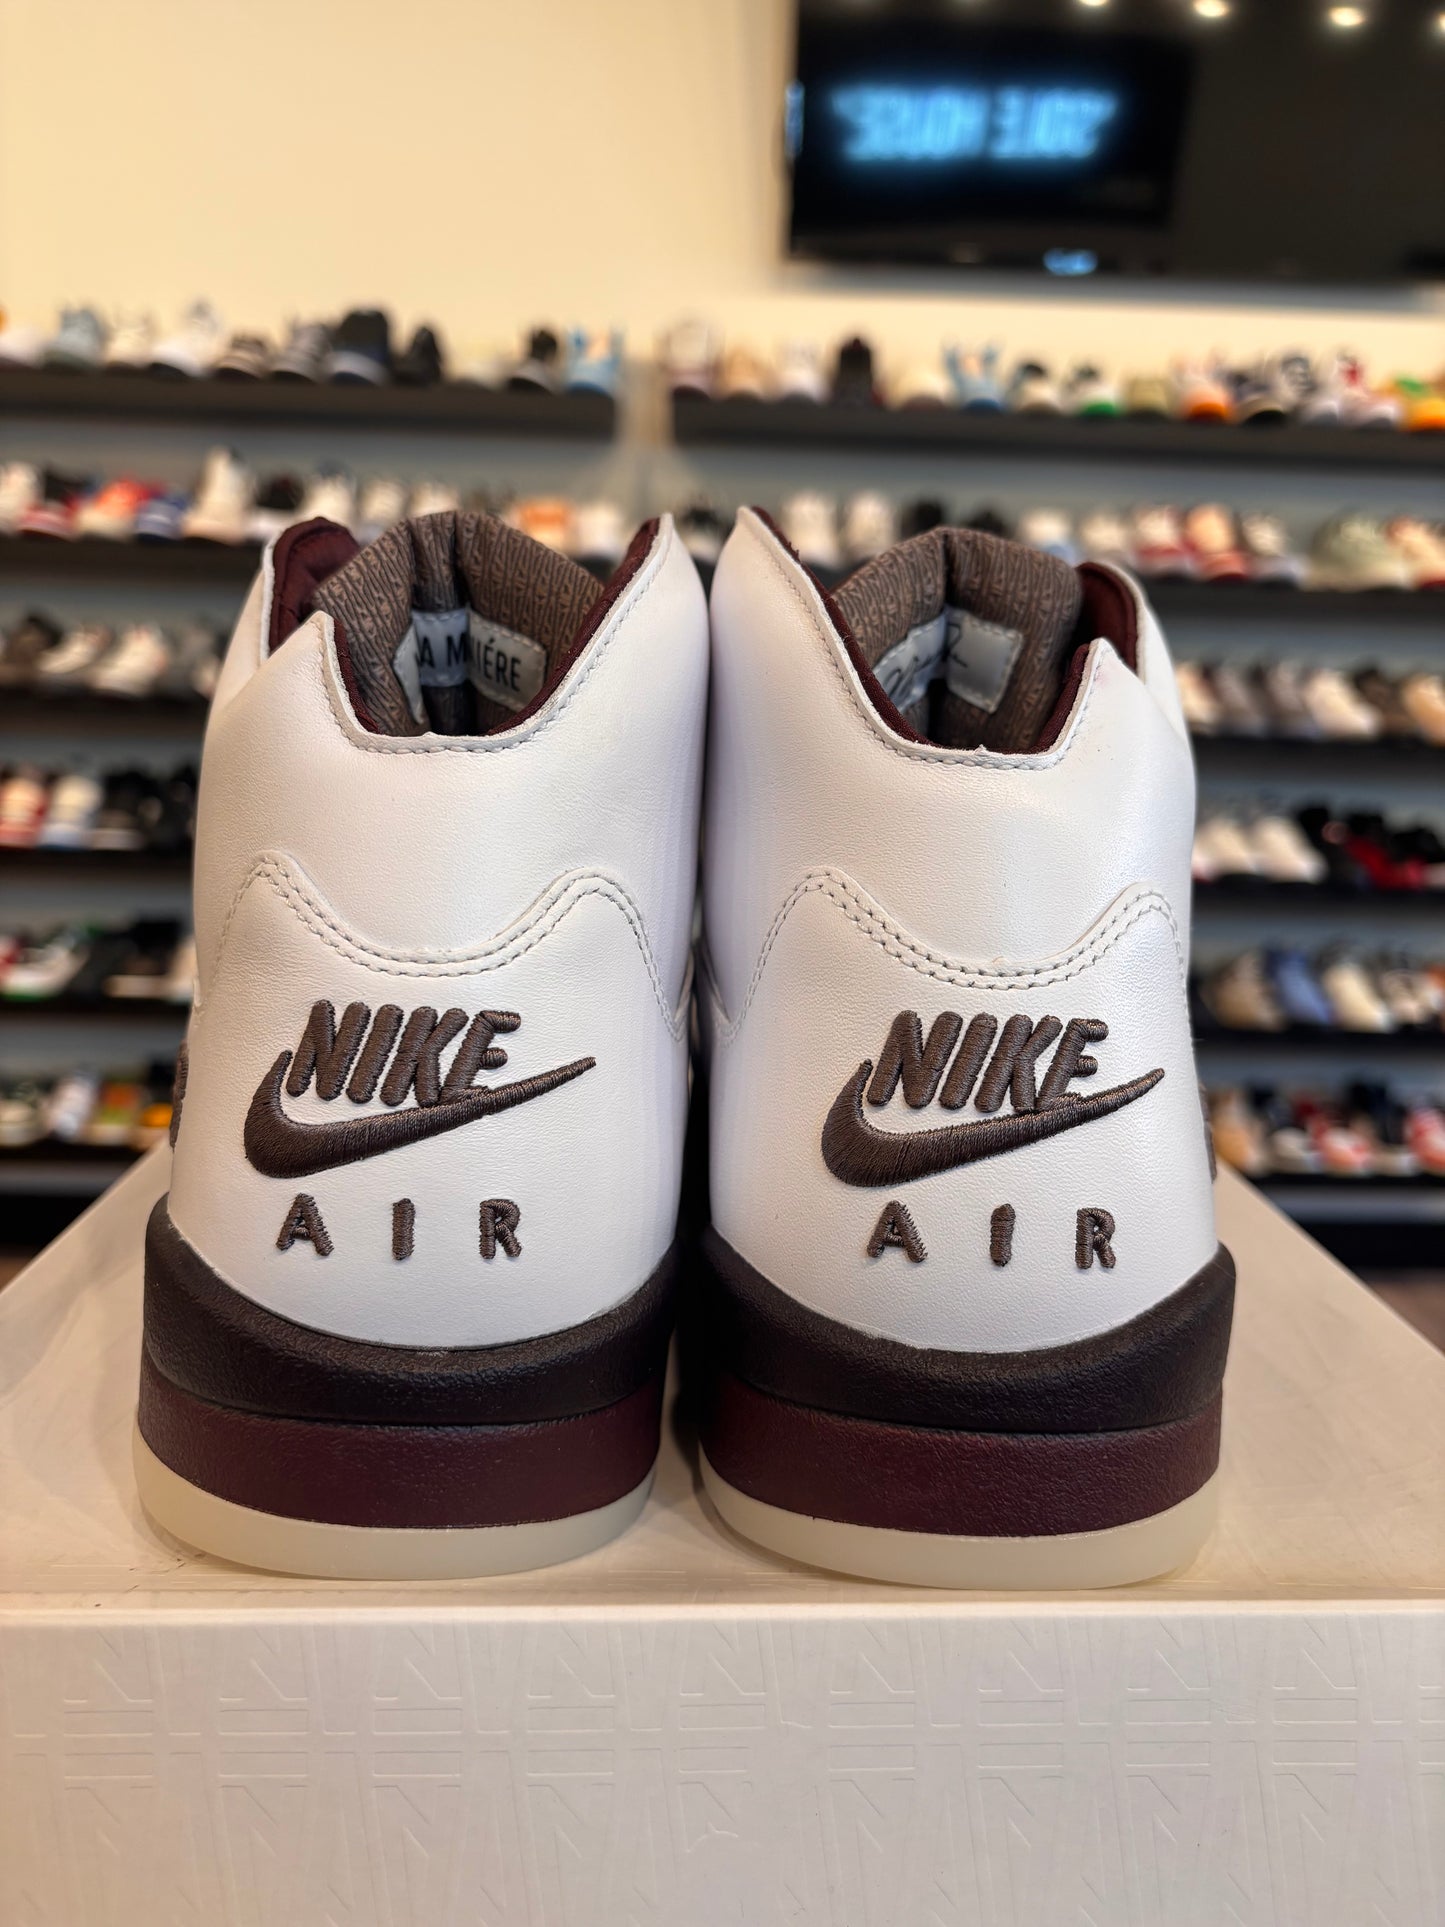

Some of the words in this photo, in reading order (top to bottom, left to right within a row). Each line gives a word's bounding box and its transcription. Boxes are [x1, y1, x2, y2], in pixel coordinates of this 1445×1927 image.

[286, 999, 522, 1109] NIKE
[867, 1010, 1109, 1114] NIKE
[276, 1193, 522, 1261] AIR
[867, 1200, 1117, 1270] AIR
